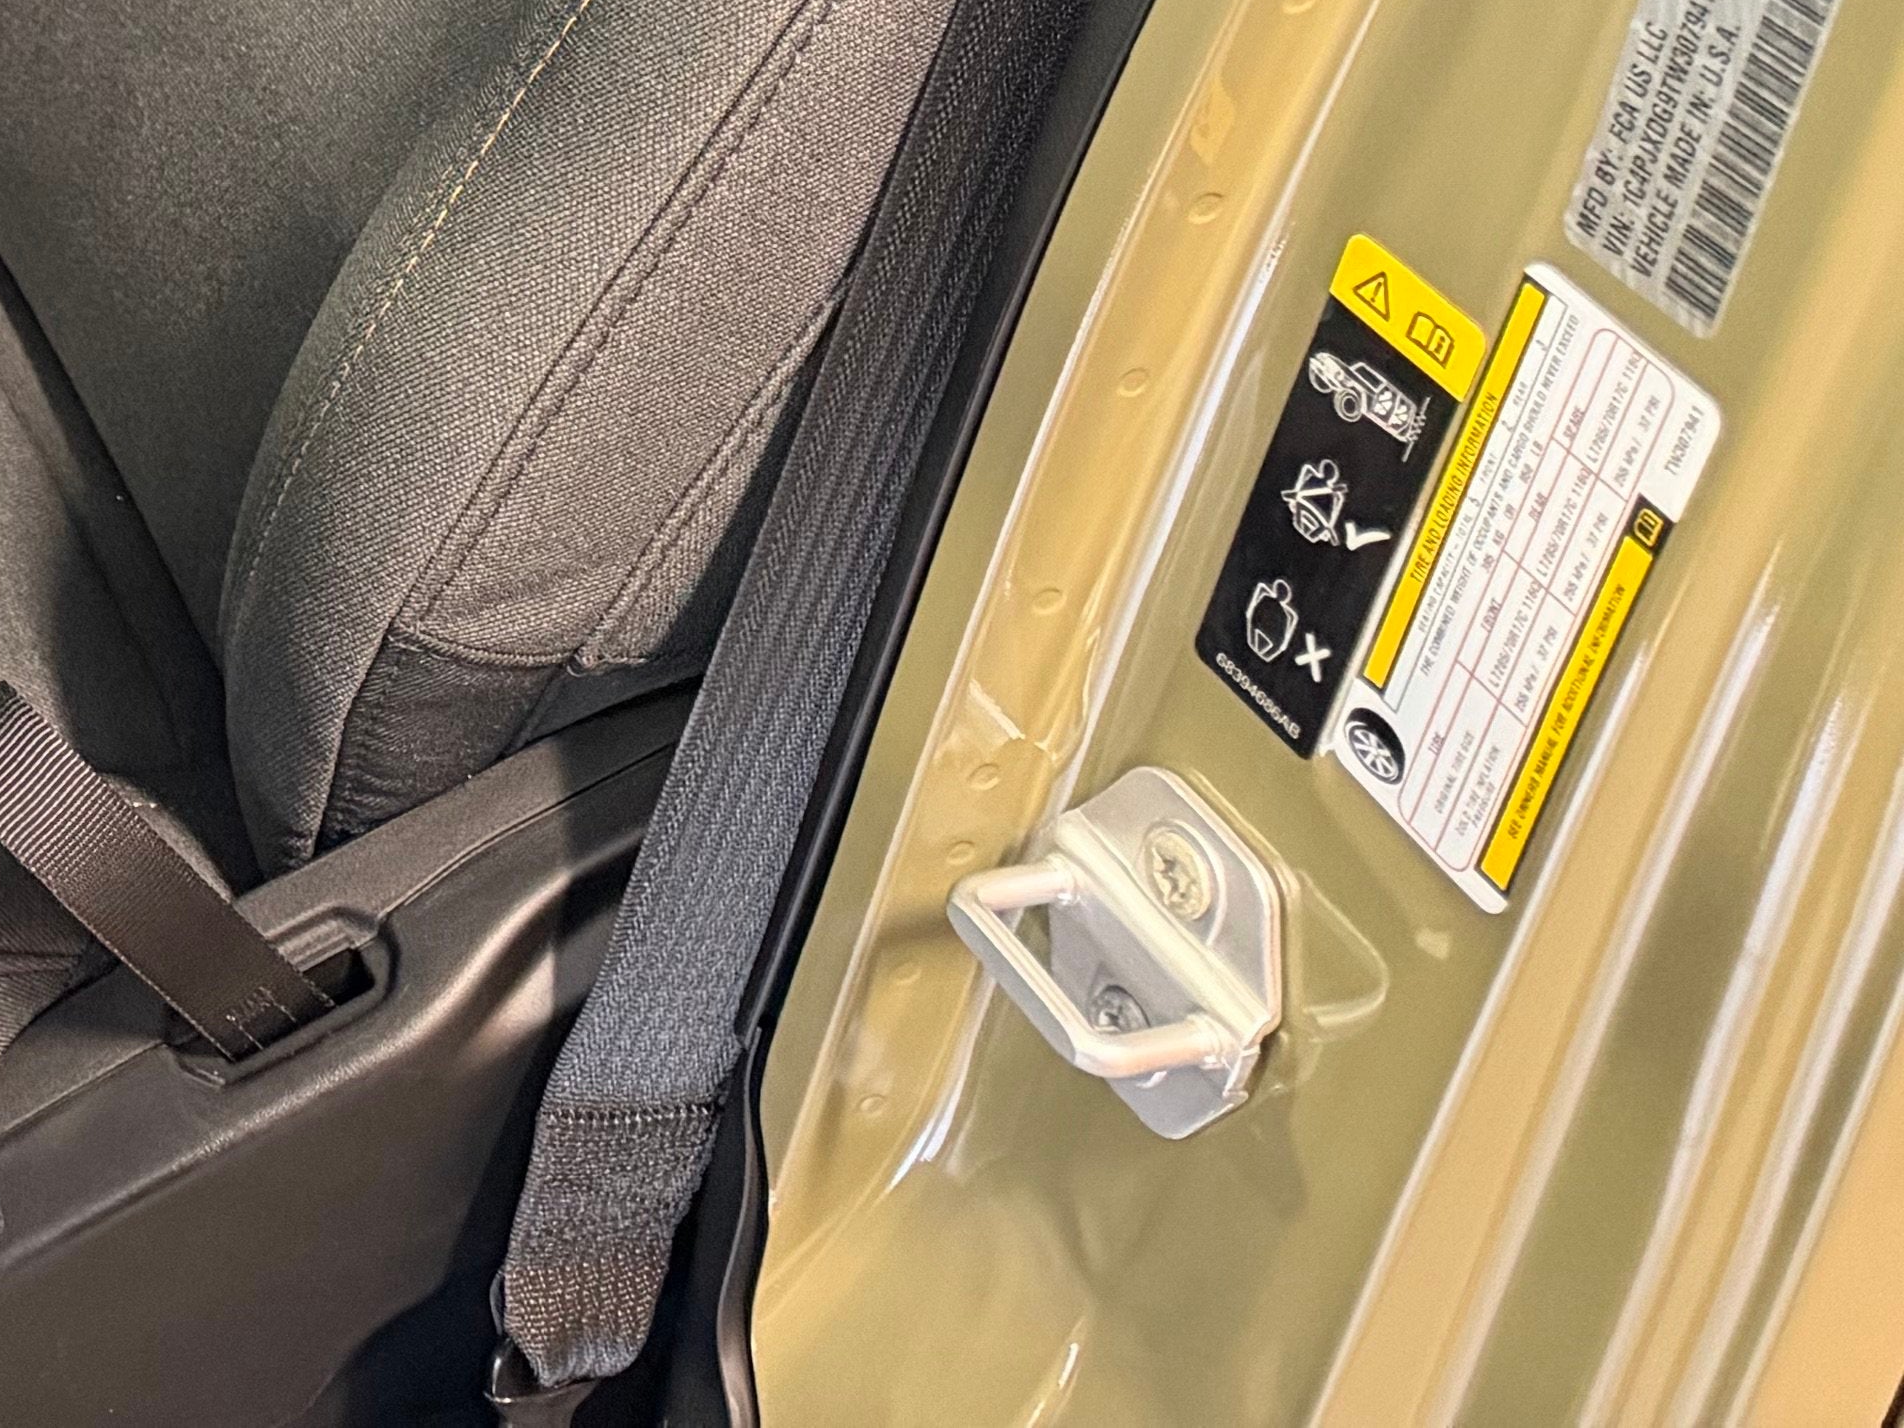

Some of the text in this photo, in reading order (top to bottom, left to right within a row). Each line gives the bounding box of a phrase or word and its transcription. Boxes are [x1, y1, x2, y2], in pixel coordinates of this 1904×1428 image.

[1574, 17, 1668, 238] MFD BY: FCA US LLC
[1628, 12, 1742, 281] VEHICLE MADE IN: U.S.A.
[1601, 207, 1635, 260] VIN:
[1562, 403, 1585, 442] SPARE
[1643, 393, 1660, 417] PSI
[1663, 402, 1704, 478] TW307941
[1409, 389, 1498, 585] TIRE AND LOADING INFORMATION
[1416, 593, 1438, 633] SEATING
[1431, 551, 1456, 597] CAPACITY
[1455, 512, 1472, 541] TOTAL
[1468, 494, 1480, 508] 5
[1478, 451, 1497, 485] FRONT
[1500, 419, 1513, 433] 2
[1511, 379, 1528, 408] REAR
[1419, 312, 1580, 677] THE COMBINED WEIGHT OF OCCUPANTS AND CARGO SHOULD NEVER EXCEED
[1491, 527, 1505, 547] KG
[1502, 501, 1516, 521] OR
[1529, 438, 1543, 458] LB
[1528, 490, 1548, 523] REAR
[1591, 509, 1608, 533] PSI
[1480, 595, 1502, 634] FRONT
[1542, 623, 1558, 646] PSI
[1427, 729, 1445, 757] TIRE
[1506, 818, 1522, 841] SEE
[1533, 734, 1558, 779] MANUAL
[1551, 711, 1568, 737] FOR
[1561, 652, 1595, 716] ADDITIONAL
[1587, 582, 1627, 656] INFORMATION
[1433, 729, 1474, 815] ORIGINAL TIRE SIZE
[1475, 743, 1500, 790] INFLATION
